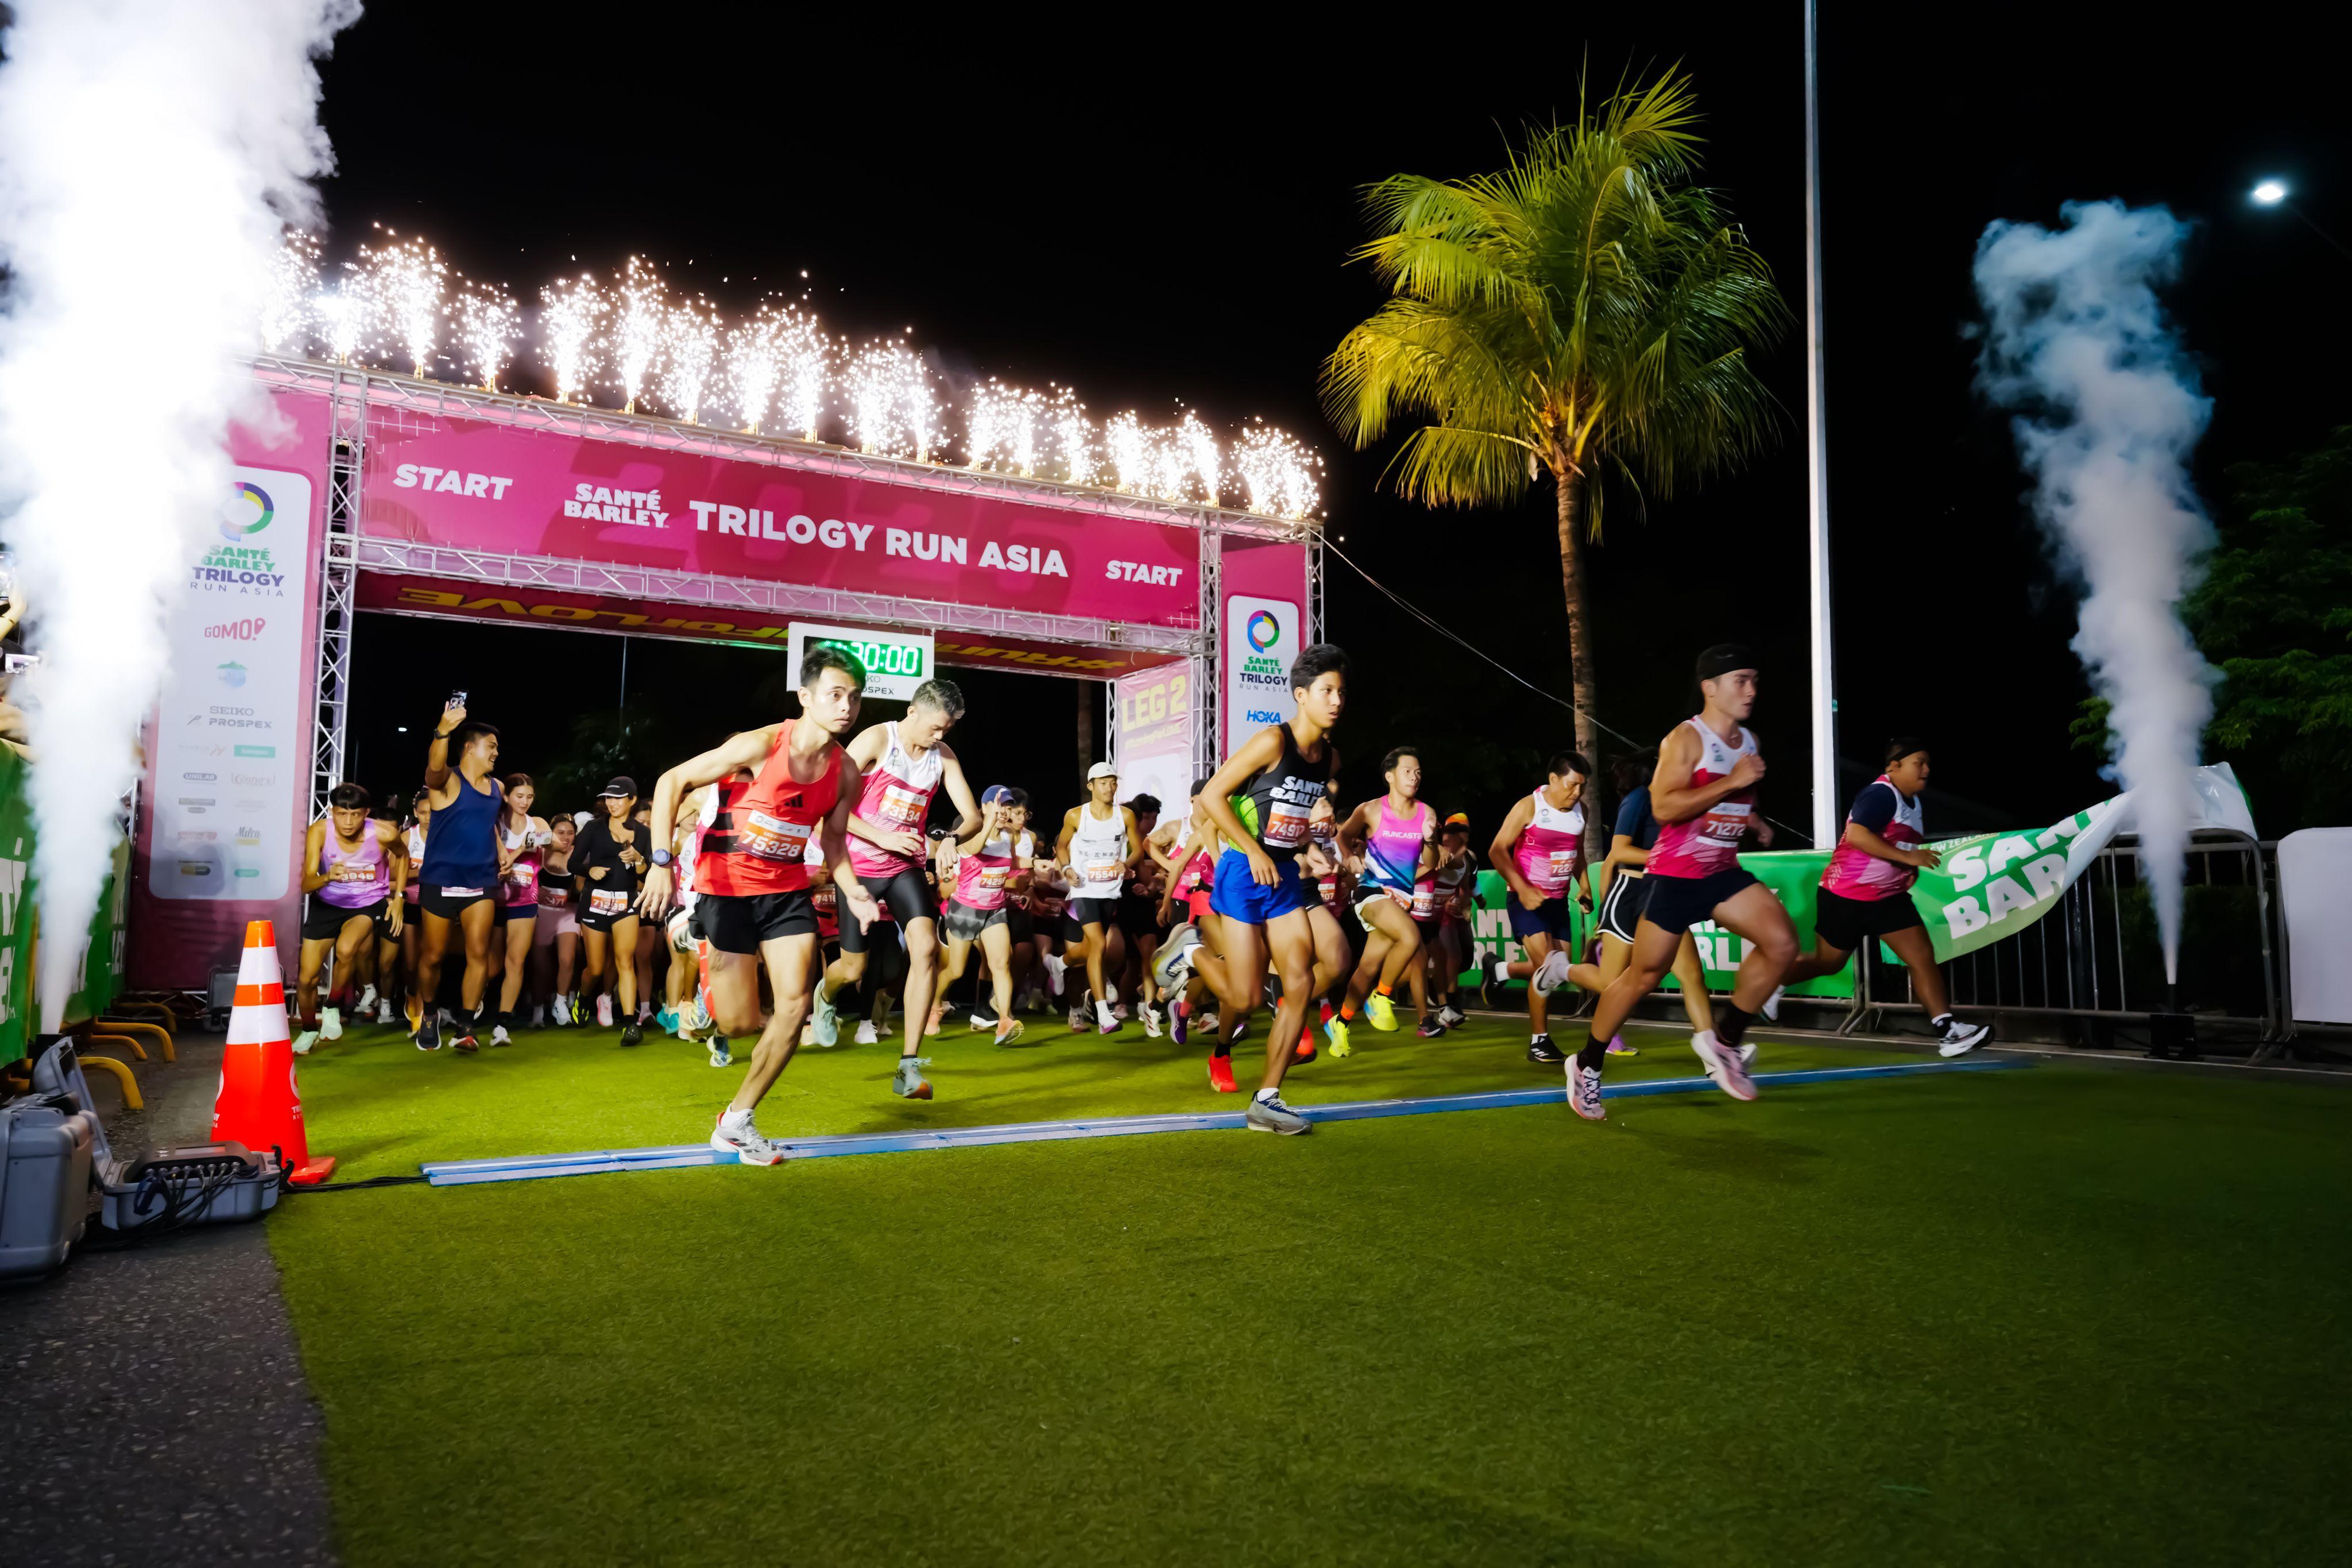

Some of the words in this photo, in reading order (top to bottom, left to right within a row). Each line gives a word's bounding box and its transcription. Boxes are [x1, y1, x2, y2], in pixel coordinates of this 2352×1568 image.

[393, 464, 513, 501] START
[575, 483, 661, 511] SANTÉ
[564, 500, 668, 528] BARLEY
[690, 500, 875, 552] TRILOGY
[886, 528, 968, 565] RUN
[978, 541, 1069, 578] ASIA
[208, 544, 270, 561] SANTÉ
[202, 555, 276, 572] BARLEY
[192, 566, 285, 587] TRILOGY
[1105, 560, 1183, 587] START
[190, 582, 227, 593] RUN
[240, 586, 284, 597] ASIA
[1244, 664, 1283, 675] BARLEY
[1248, 656, 1280, 667] SANTÉ
[1240, 672, 1288, 686] TRILOGY
[210, 706, 254, 716] SEIKO
[1121, 683, 1167, 732] LEG
[1170, 675, 1187, 715] 2
[208, 718, 272, 729] PROSPEX
[1247, 710, 1281, 723] HOKA
[185, 773, 215, 781] UNILAB
[881, 800, 920, 822] 73334
[741, 830, 801, 857] 75328
[1942, 853, 2068, 939] BAR
